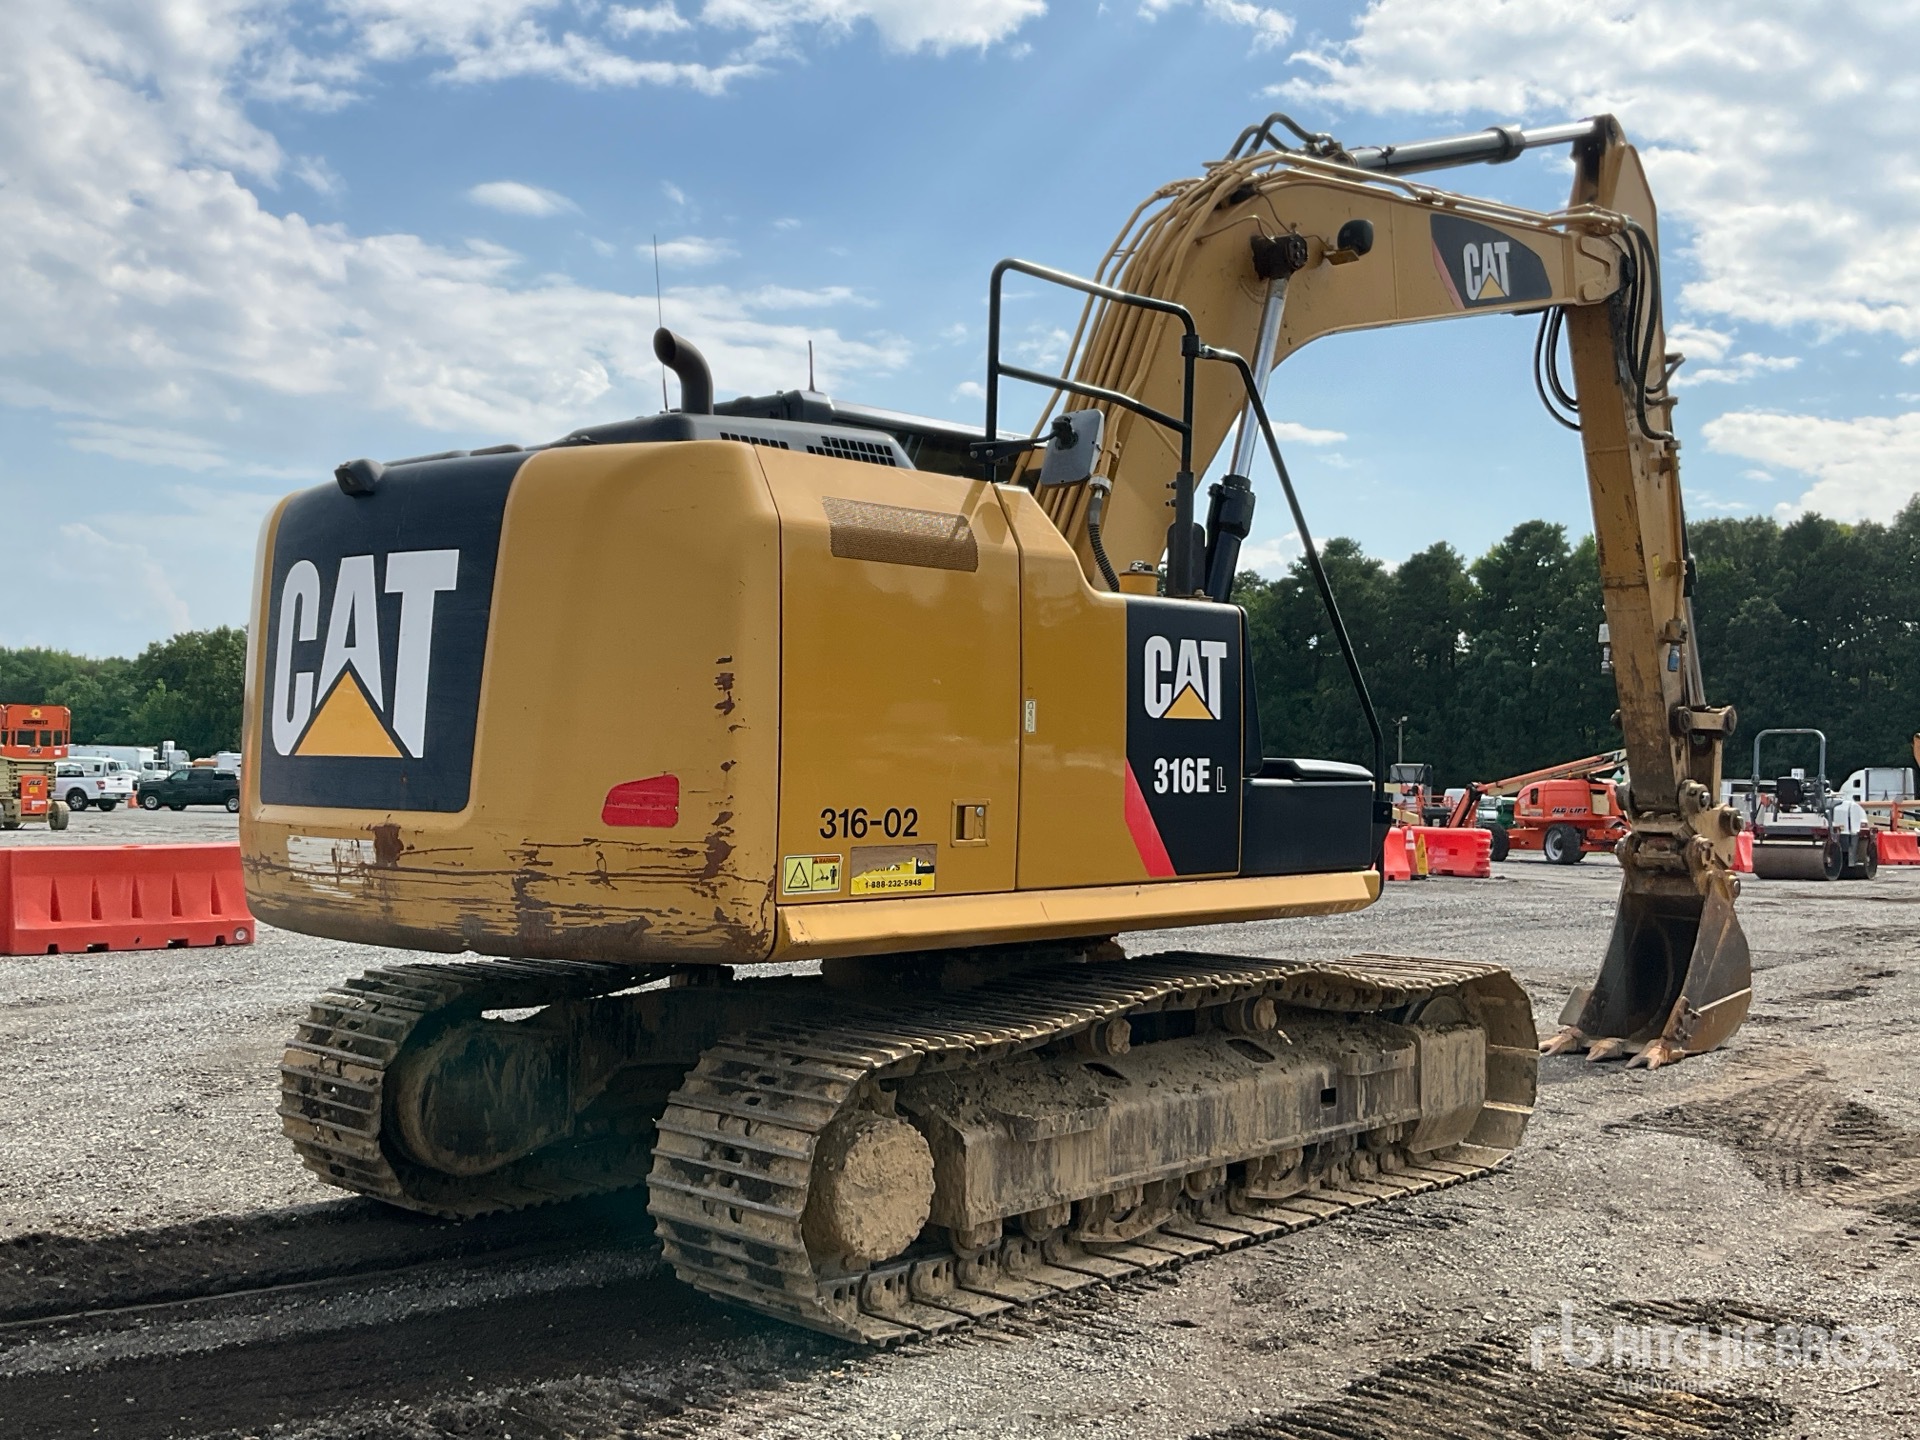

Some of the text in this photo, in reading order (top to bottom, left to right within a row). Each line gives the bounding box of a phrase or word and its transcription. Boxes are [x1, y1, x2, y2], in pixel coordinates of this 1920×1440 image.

[1463, 241, 1510, 301] CAT
[271, 548, 460, 759] CAT
[1144, 635, 1228, 720] CAT
[1153, 757, 1227, 794] 316E L
[819, 807, 919, 839] 316-02
